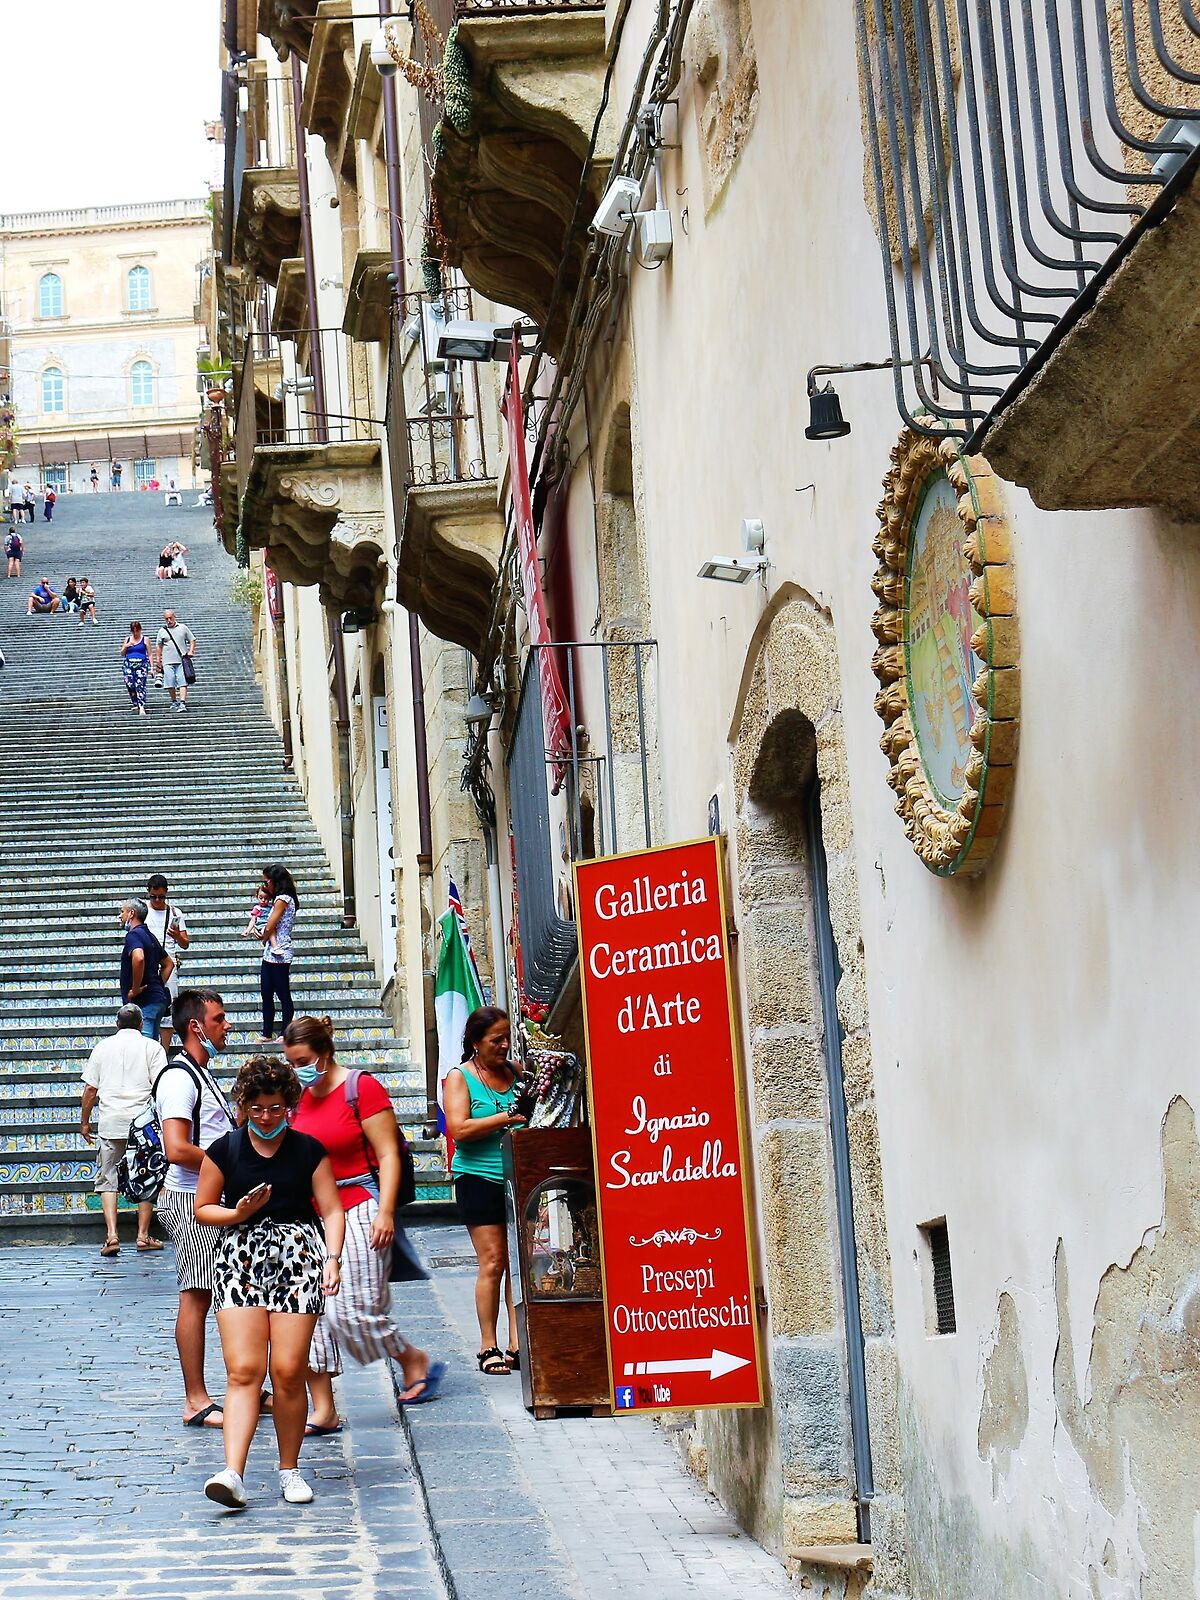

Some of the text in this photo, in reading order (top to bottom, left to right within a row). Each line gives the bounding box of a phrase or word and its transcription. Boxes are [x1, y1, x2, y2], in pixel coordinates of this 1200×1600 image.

[594, 869, 708, 920] Galleria
[589, 928, 723, 979] Ceramica
[617, 992, 701, 1034] d'Arte
[653, 1053, 673, 1077] di
[624, 1095, 710, 1144] Ignazio
[605, 1138, 738, 1189] Scarlatella
[640, 1258, 716, 1298] Presepi
[613, 1294, 751, 1334] Ottocenteschi
